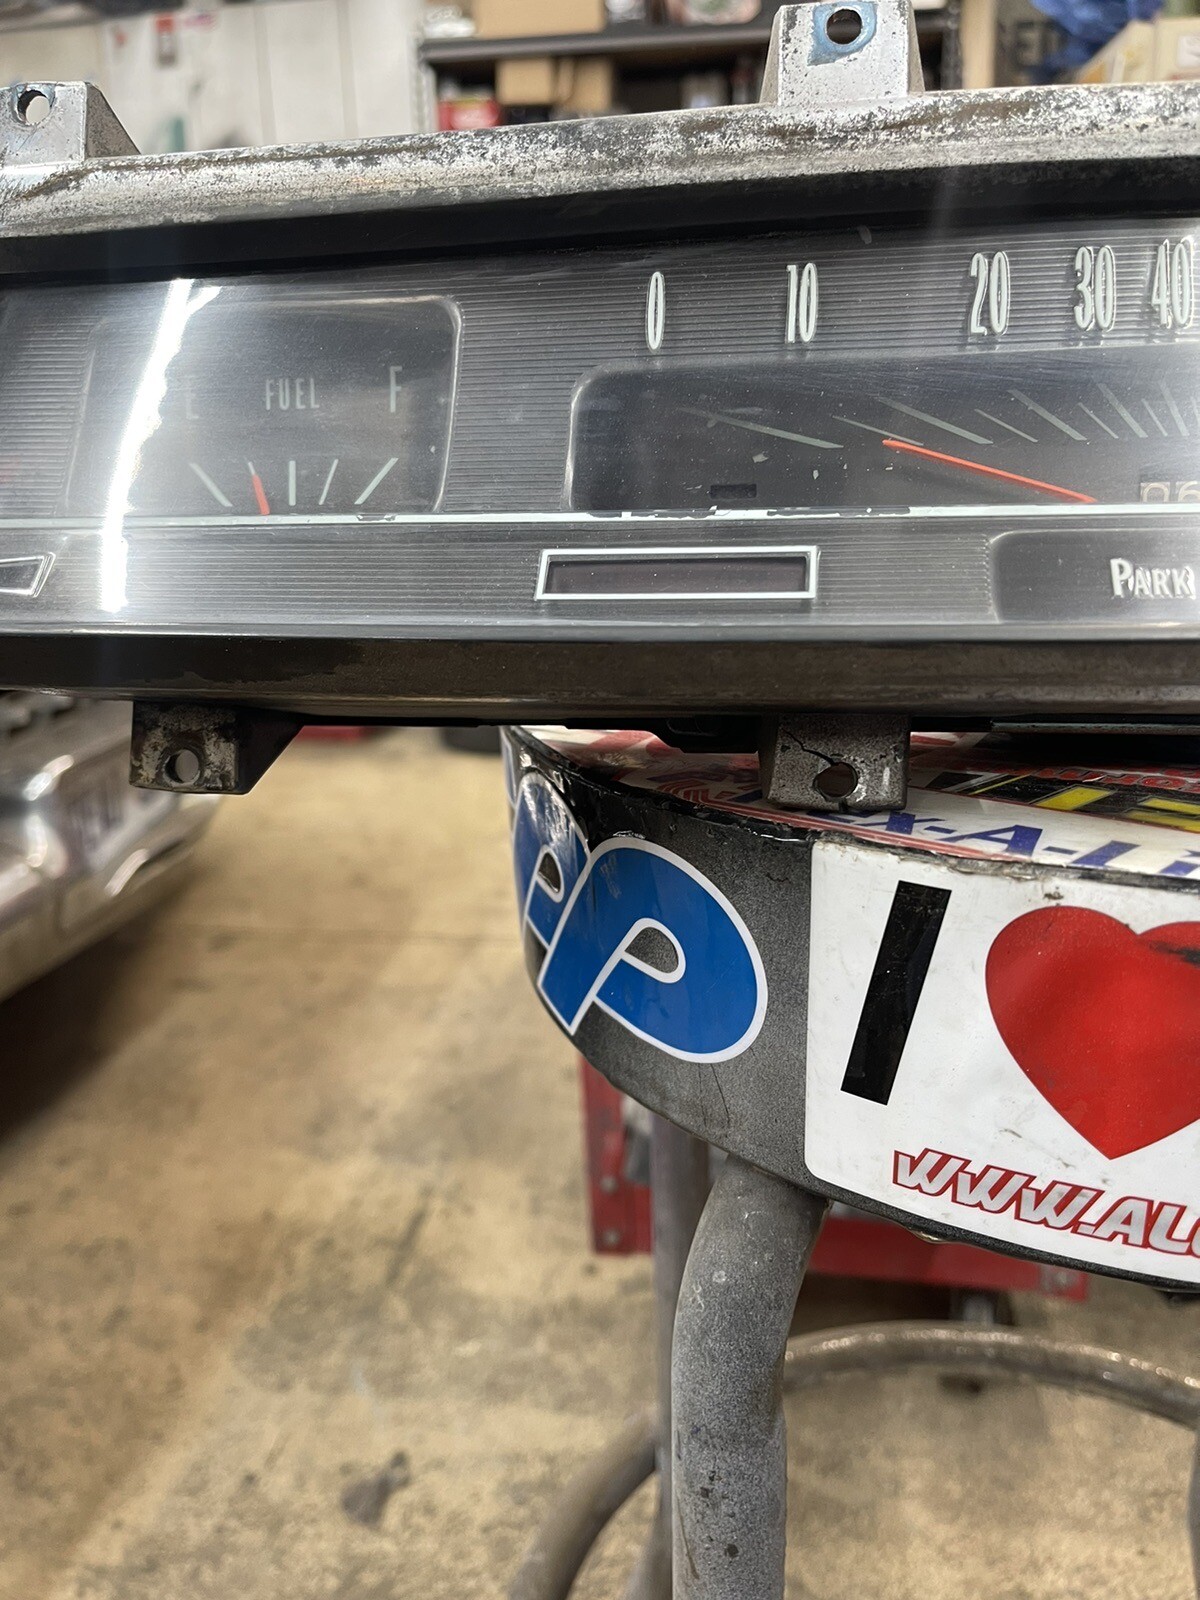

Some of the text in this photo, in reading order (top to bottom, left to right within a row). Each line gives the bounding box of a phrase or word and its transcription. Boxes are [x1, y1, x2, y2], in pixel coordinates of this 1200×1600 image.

[647, 238, 1194, 350] 0 10 20 30 40
[265, 377, 320, 411] FUEL
[389, 365, 403, 413] F
[840, 879, 953, 1106] I
